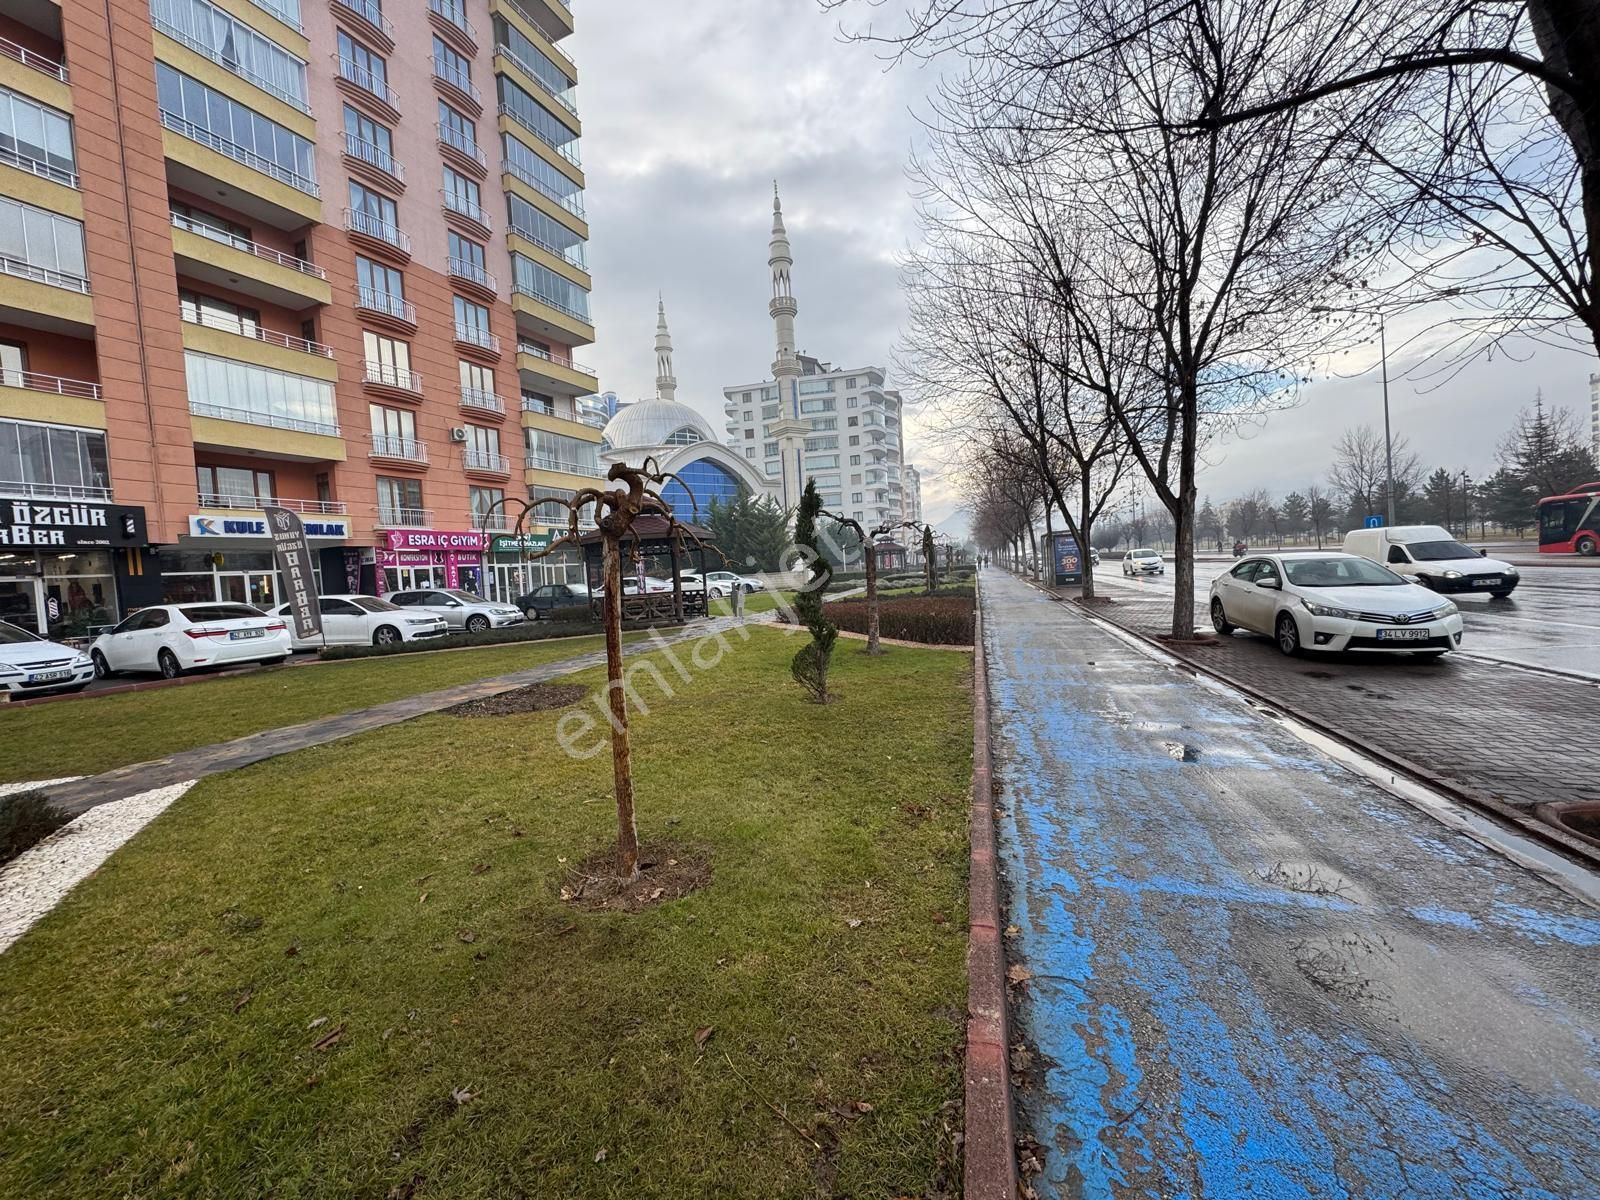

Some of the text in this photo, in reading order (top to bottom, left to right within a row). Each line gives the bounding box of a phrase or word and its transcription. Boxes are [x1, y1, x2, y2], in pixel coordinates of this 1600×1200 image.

[11, 501, 107, 526] ÖZGÜR
[223, 520, 265, 534] KULE
[303, 523, 345, 536] EMLAK
[408, 534, 436, 546] ESRA
[1383, 630, 1428, 638] 34 LV 9912
